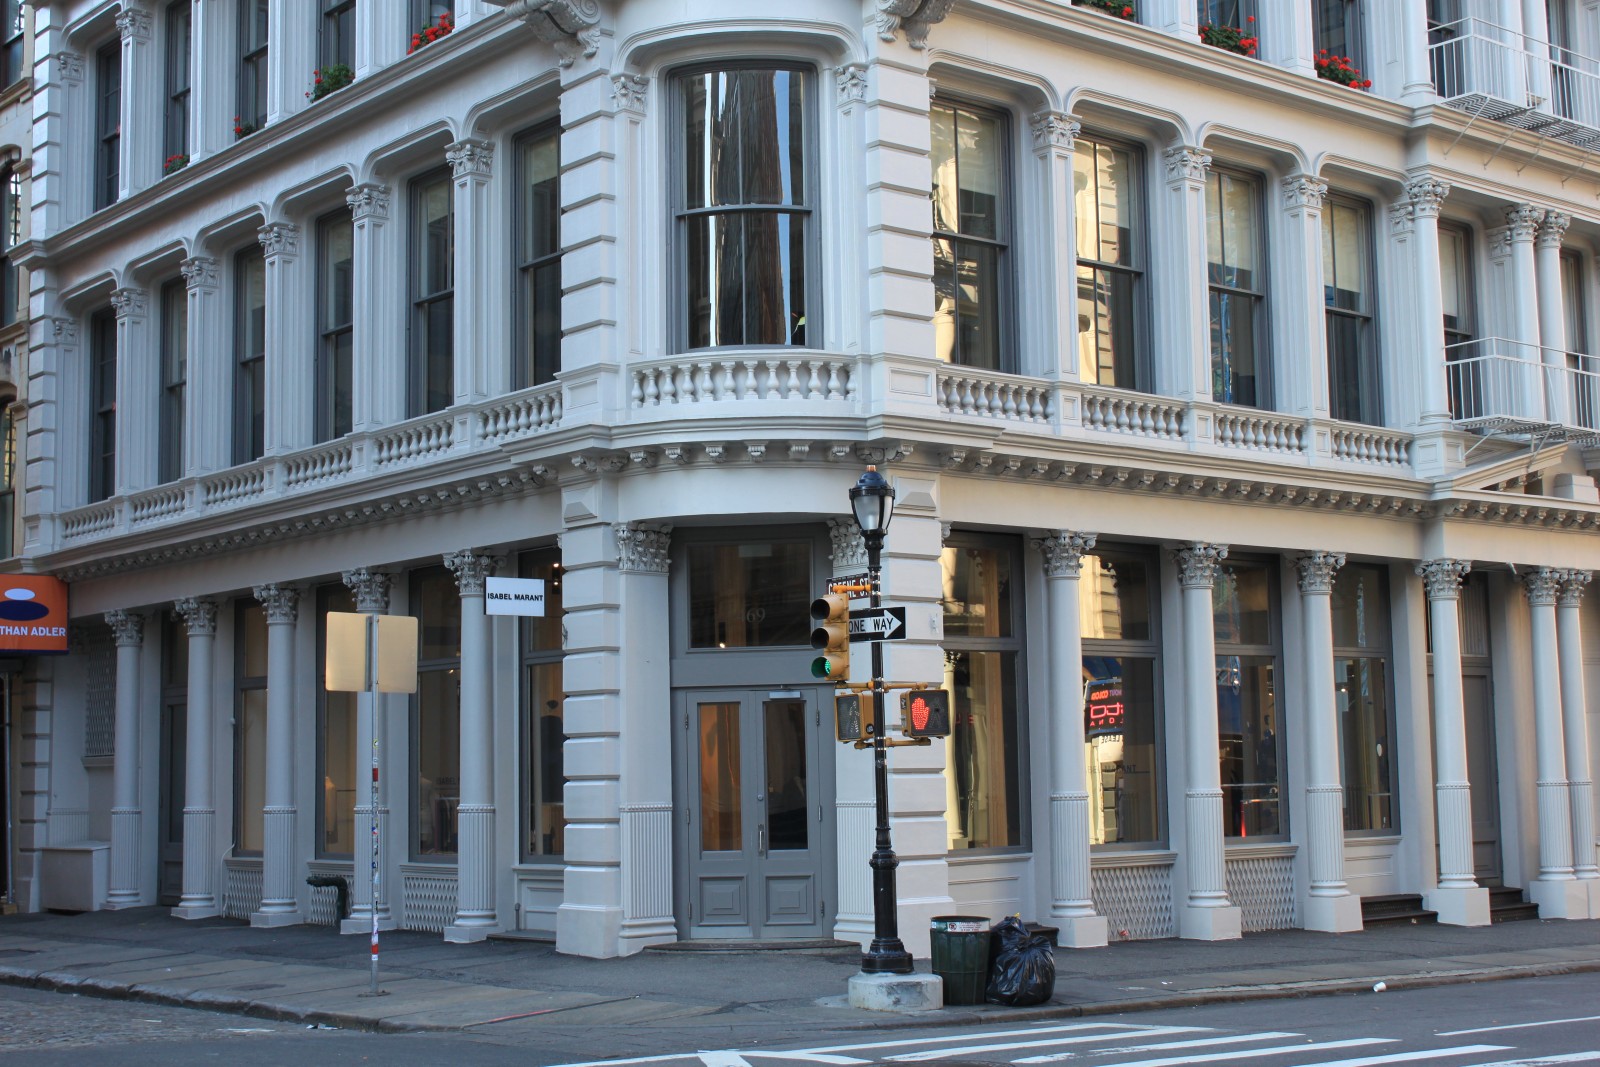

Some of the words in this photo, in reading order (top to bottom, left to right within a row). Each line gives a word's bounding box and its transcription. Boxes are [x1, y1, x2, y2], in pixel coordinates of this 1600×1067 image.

[828, 579, 857, 598] GNE
[487, 592, 512, 600] ISABEL
[514, 593, 543, 602] MARANT
[0, 625, 28, 636] THAN
[30, 626, 66, 636] ADLER
[849, 619, 866, 632] ONE
[873, 617, 894, 631] WAY
